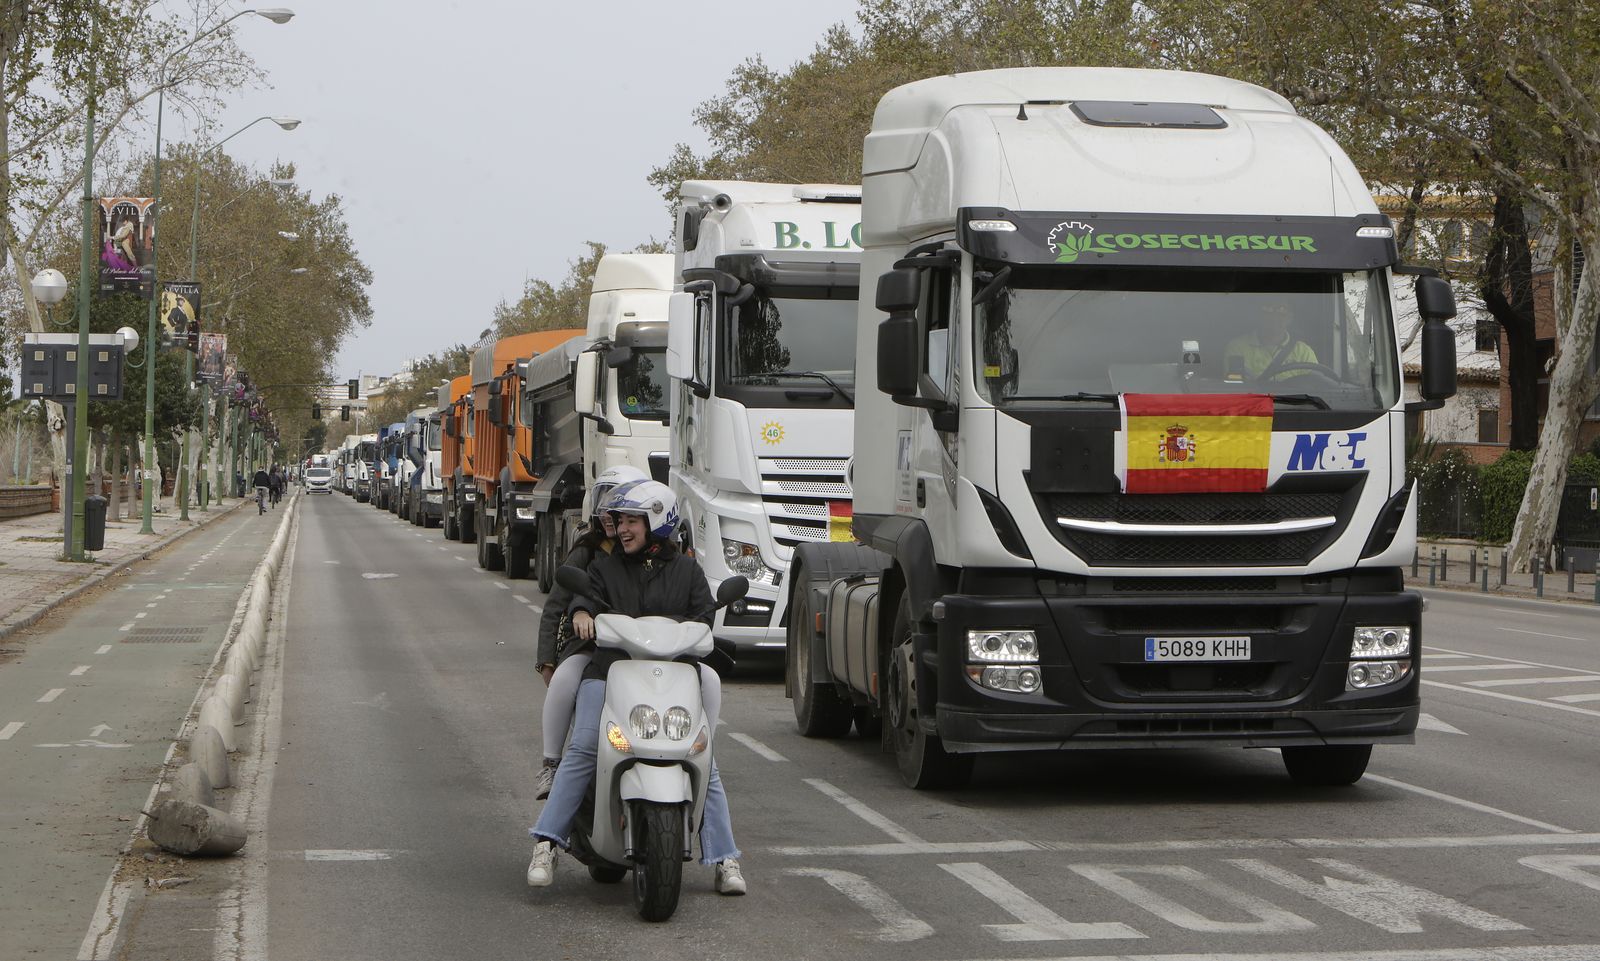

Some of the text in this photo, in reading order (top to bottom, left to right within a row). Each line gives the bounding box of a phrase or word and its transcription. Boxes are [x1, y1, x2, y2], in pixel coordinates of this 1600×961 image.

[103, 207, 152, 216] VILA
[771, 221, 811, 249] B.
[1095, 233, 1318, 252] COSECHASUR
[766, 429, 779, 437] 46
[1158, 640, 1206, 657] 5089
[1212, 640, 1247, 657] KHH
